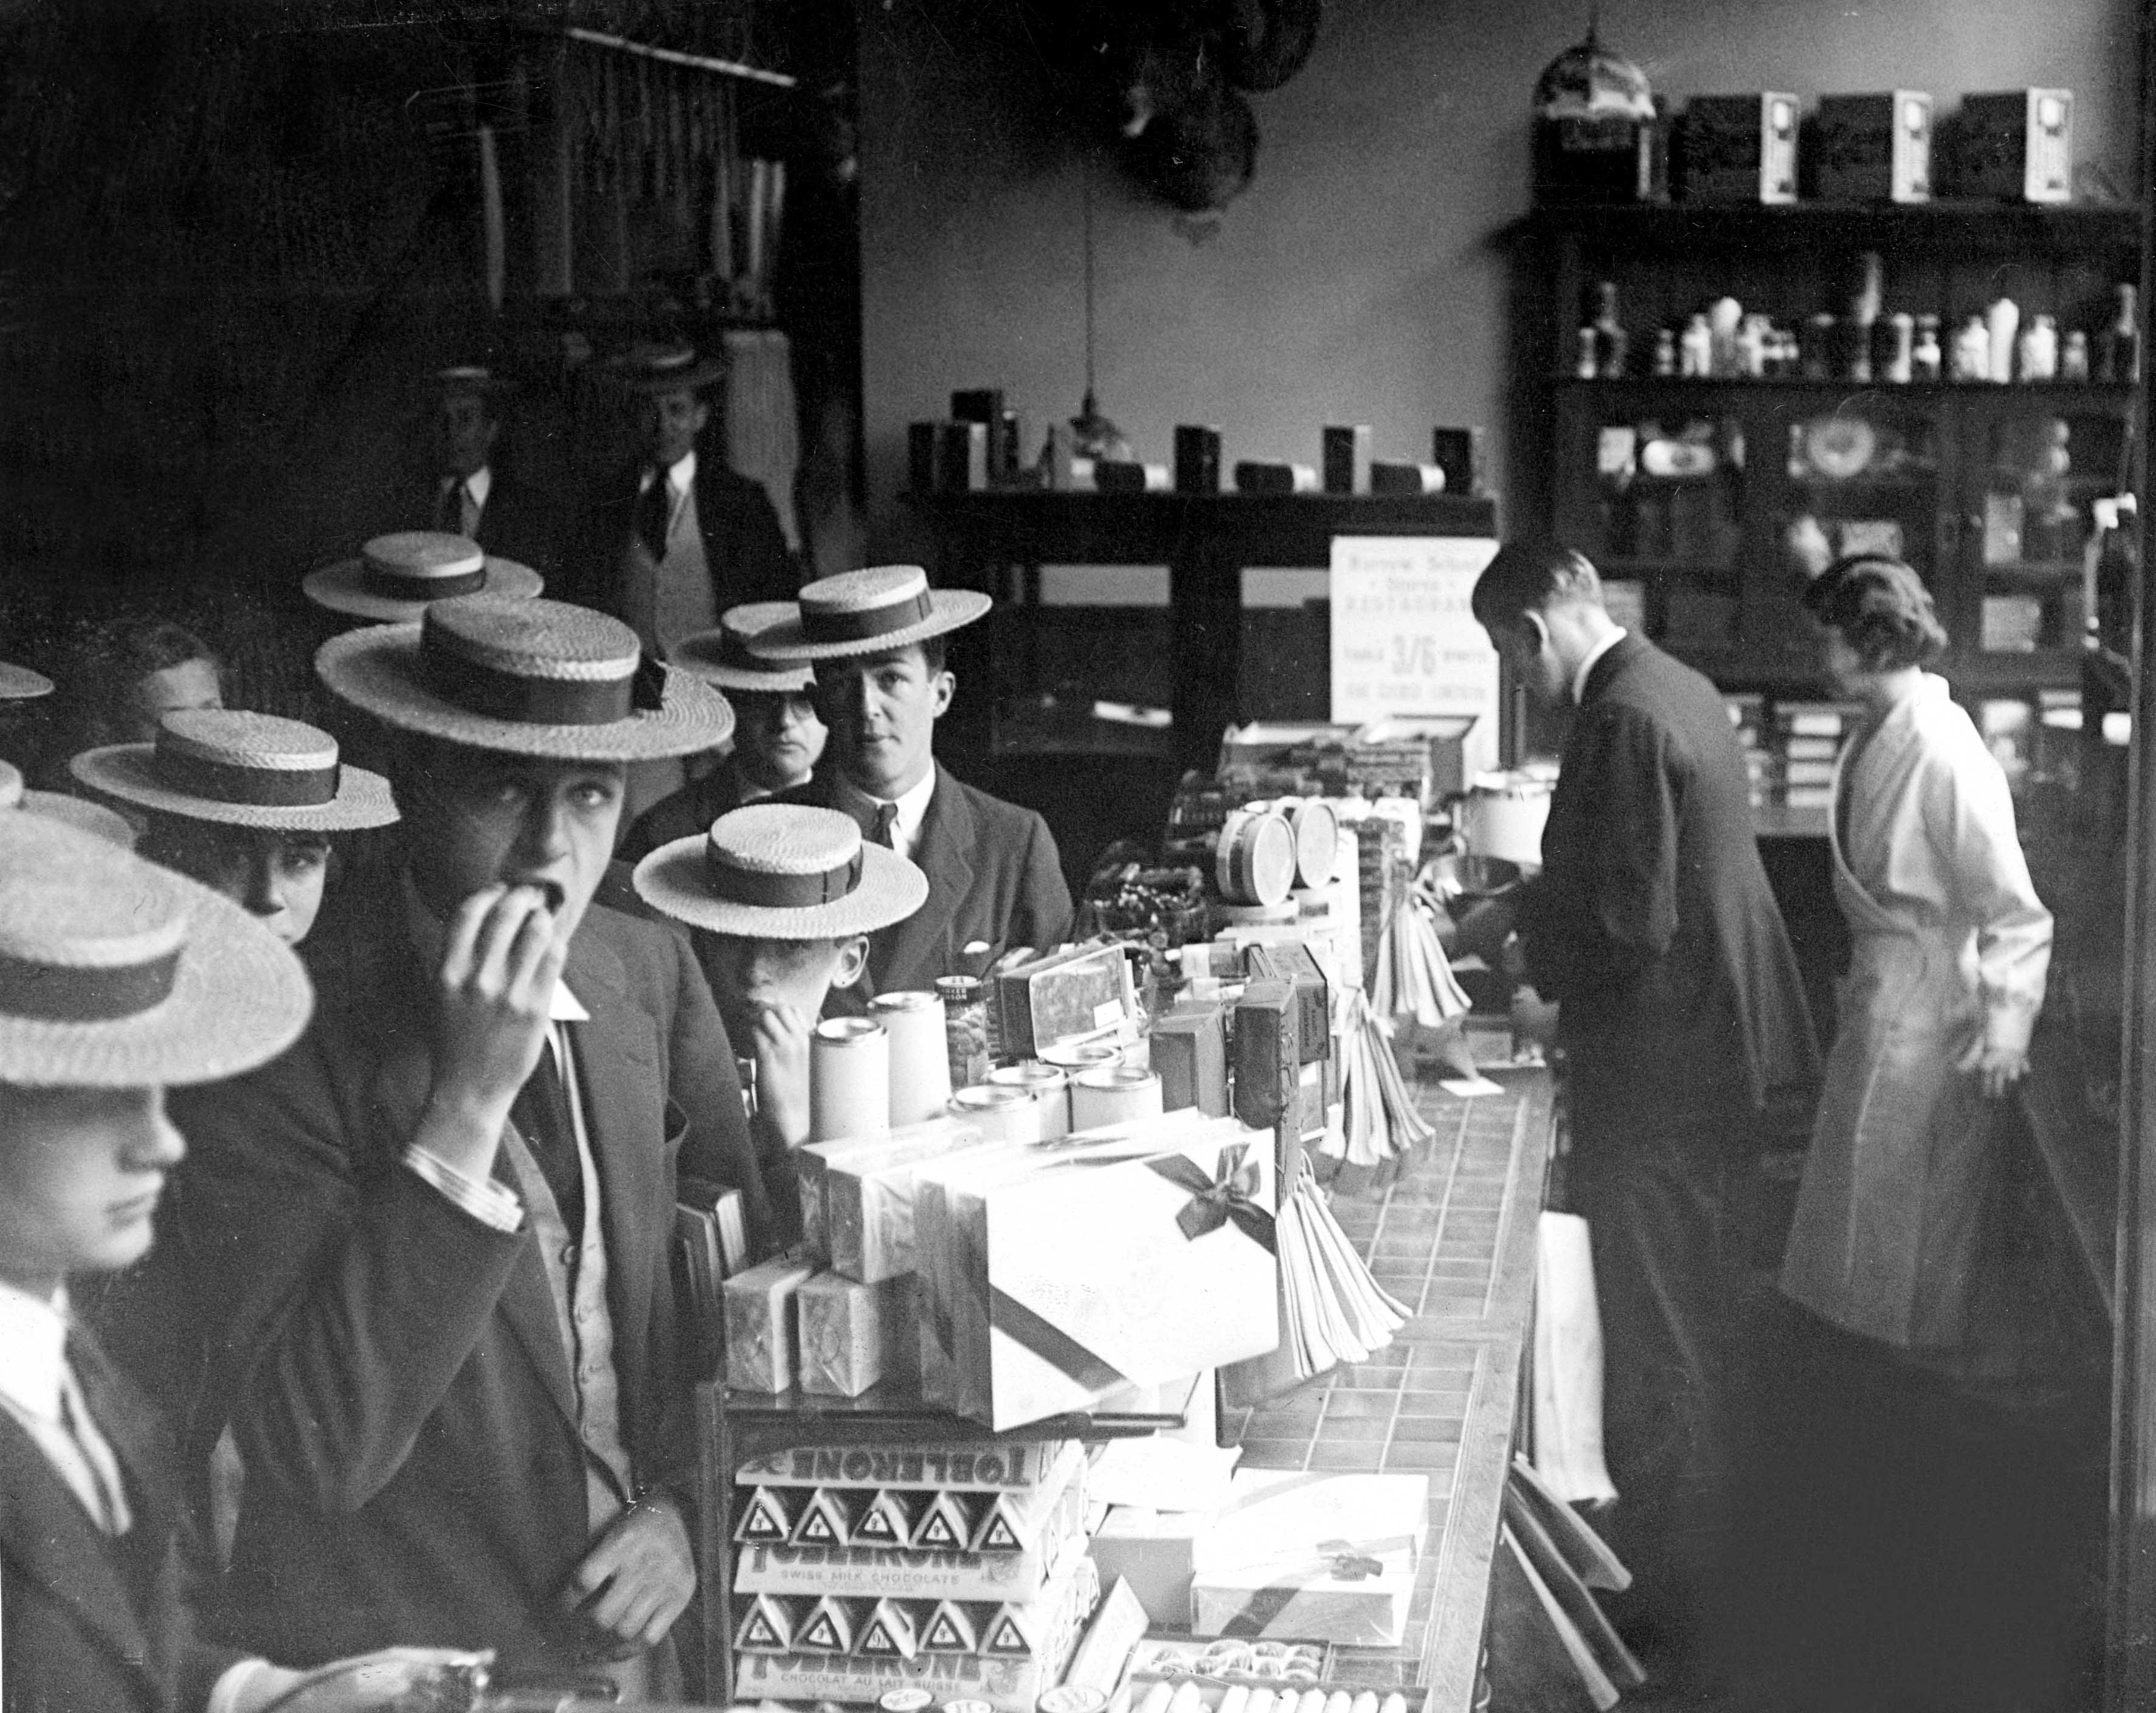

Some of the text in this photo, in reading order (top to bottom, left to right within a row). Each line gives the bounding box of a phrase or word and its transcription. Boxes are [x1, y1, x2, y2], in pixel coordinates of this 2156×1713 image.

[1392, 633, 1437, 676] 3/6
[791, 1446, 1031, 1487] TOBLERONE
[781, 1570, 959, 1585] SWISS MILK CHOCOLATE
[781, 1672, 848, 1684] CHOCOLAT
[855, 1676, 871, 1686] AU
